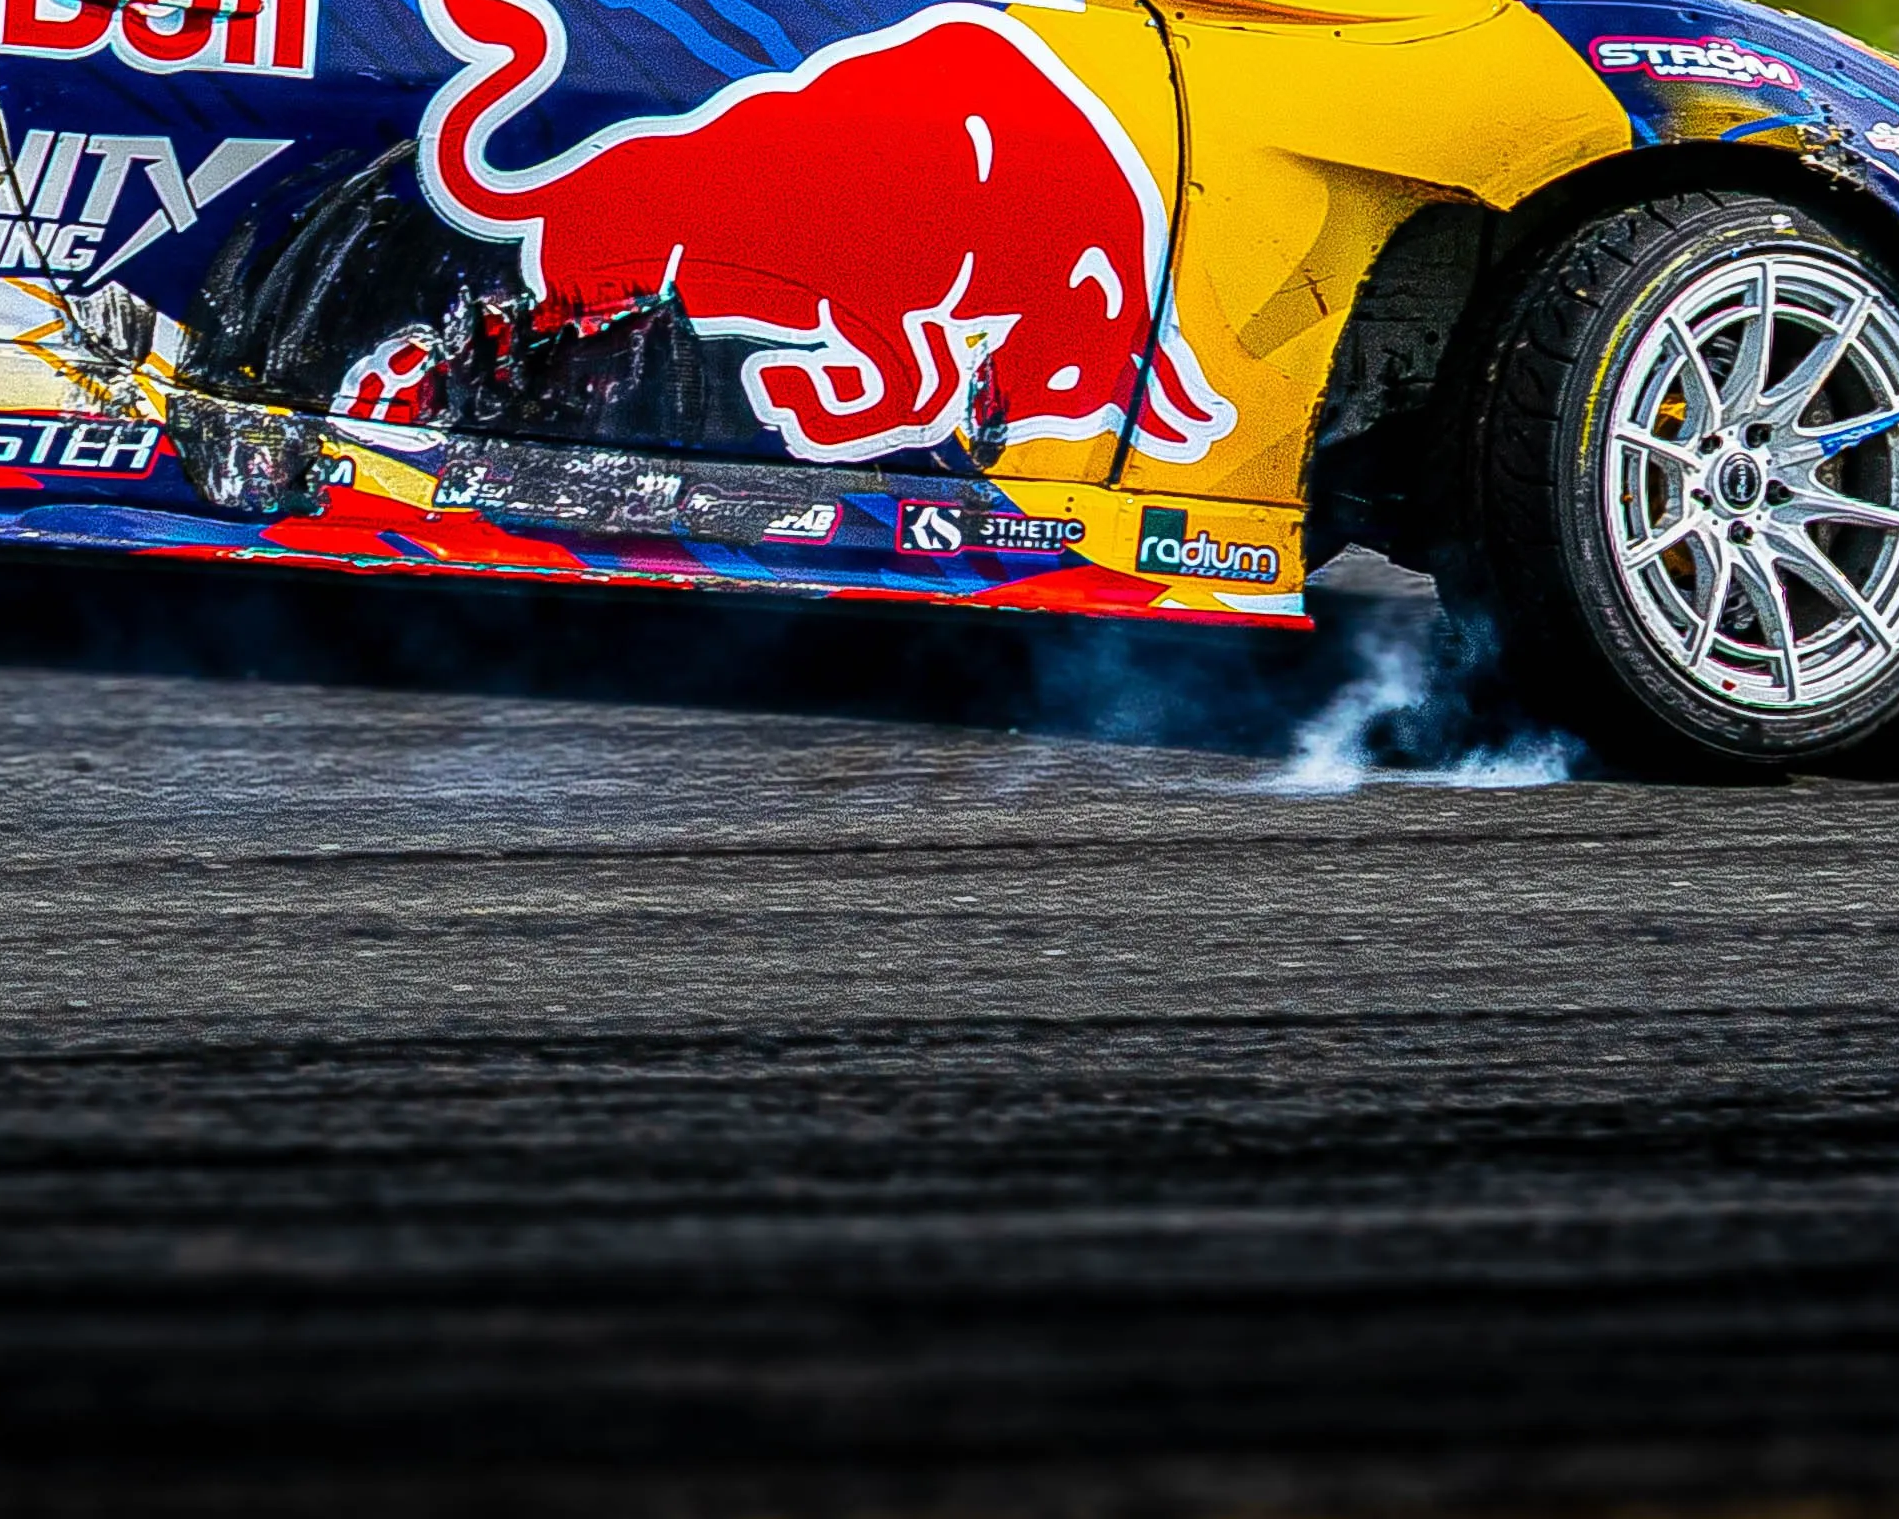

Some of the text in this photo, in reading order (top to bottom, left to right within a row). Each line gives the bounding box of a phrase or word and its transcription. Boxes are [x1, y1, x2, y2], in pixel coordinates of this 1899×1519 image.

[1599, 42, 1794, 85] STRÖM
[978, 517, 1086, 541] STHETIC
[1140, 532, 1277, 575] radium
